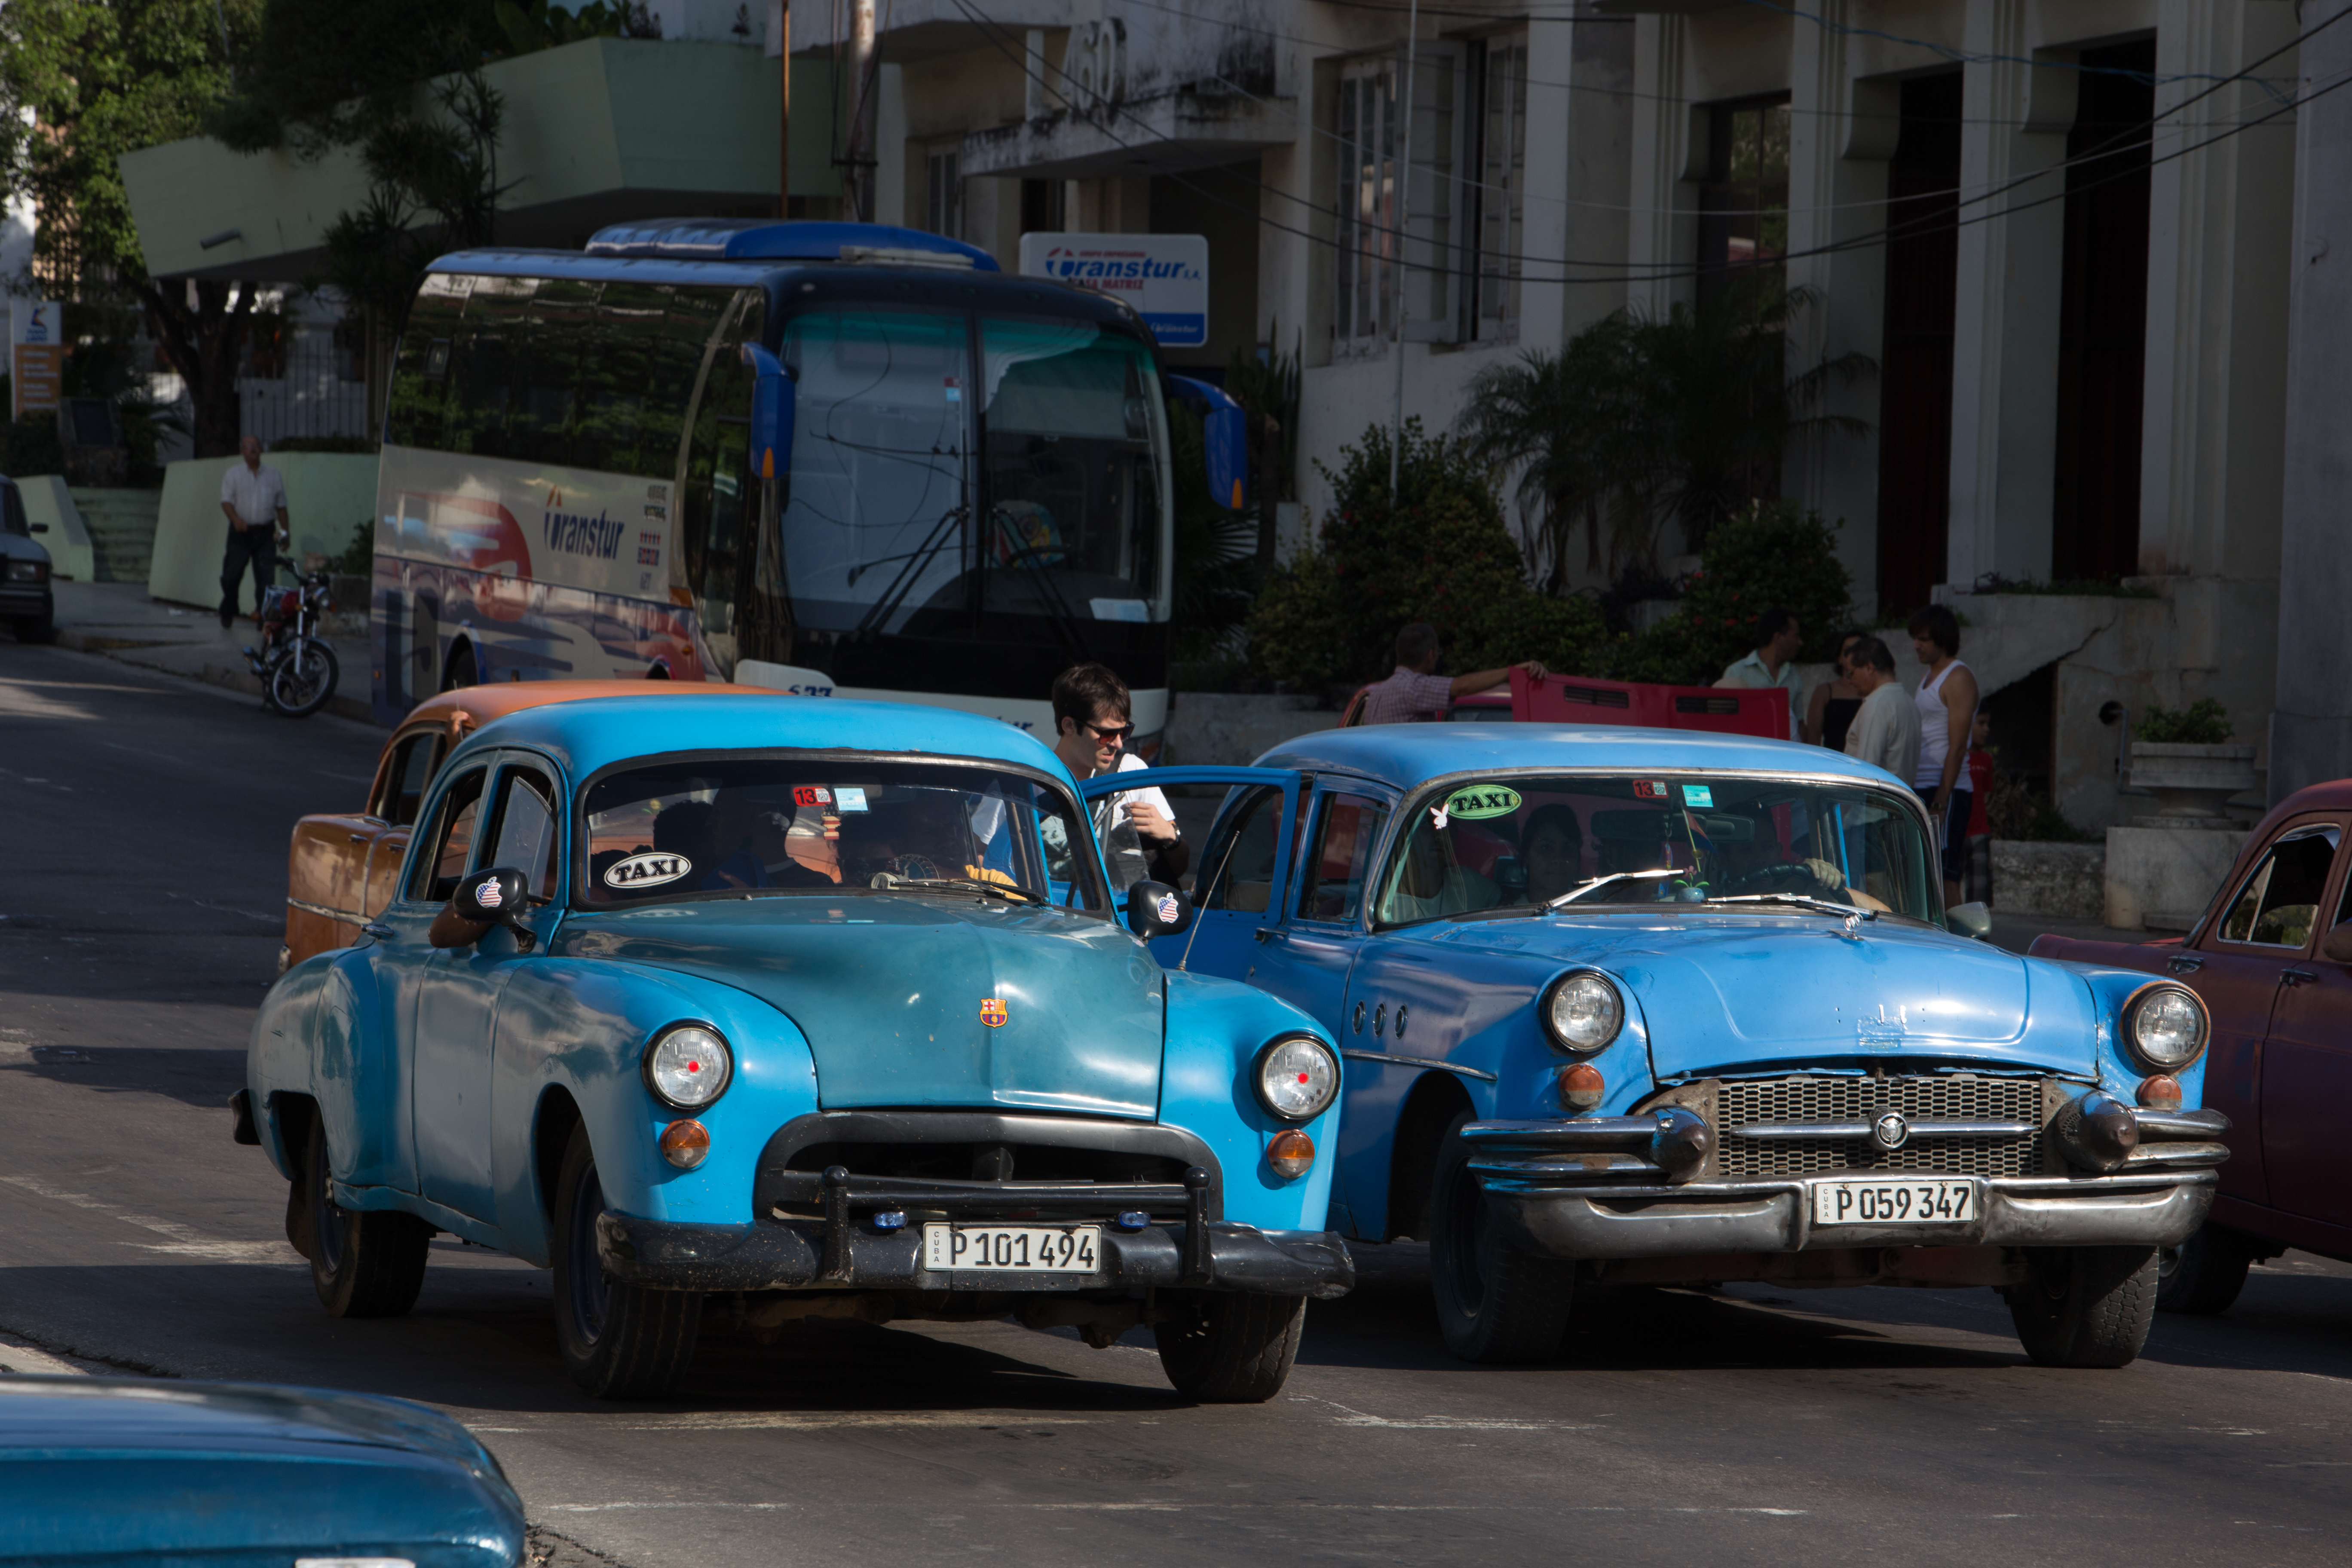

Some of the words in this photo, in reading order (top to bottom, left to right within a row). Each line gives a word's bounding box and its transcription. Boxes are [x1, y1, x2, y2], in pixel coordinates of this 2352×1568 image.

[1102, 279, 1144, 291] MATRIZ
[795, 788, 817, 804] 13
[1635, 782, 1654, 796] 13
[1451, 792, 1513, 813] TAXI
[614, 858, 680, 883] TAXI
